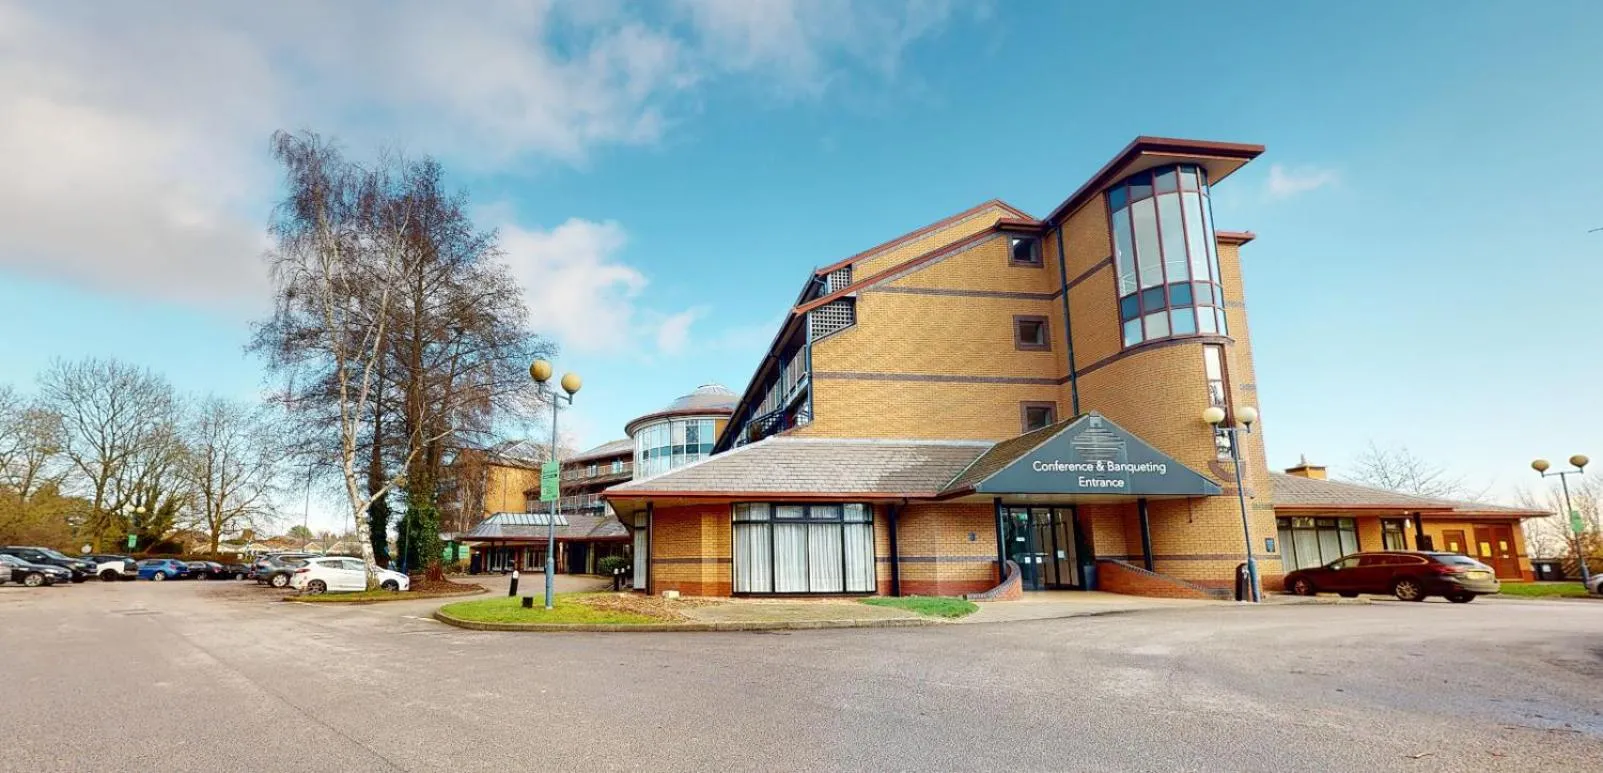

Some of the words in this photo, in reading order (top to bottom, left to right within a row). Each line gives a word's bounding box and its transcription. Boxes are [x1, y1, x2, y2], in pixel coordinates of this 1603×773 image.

[1032, 460, 1094, 472] Conference
[1096, 460, 1105, 472] &
[1107, 460, 1167, 475] Banqueting
[1078, 476, 1125, 488] Entrance
